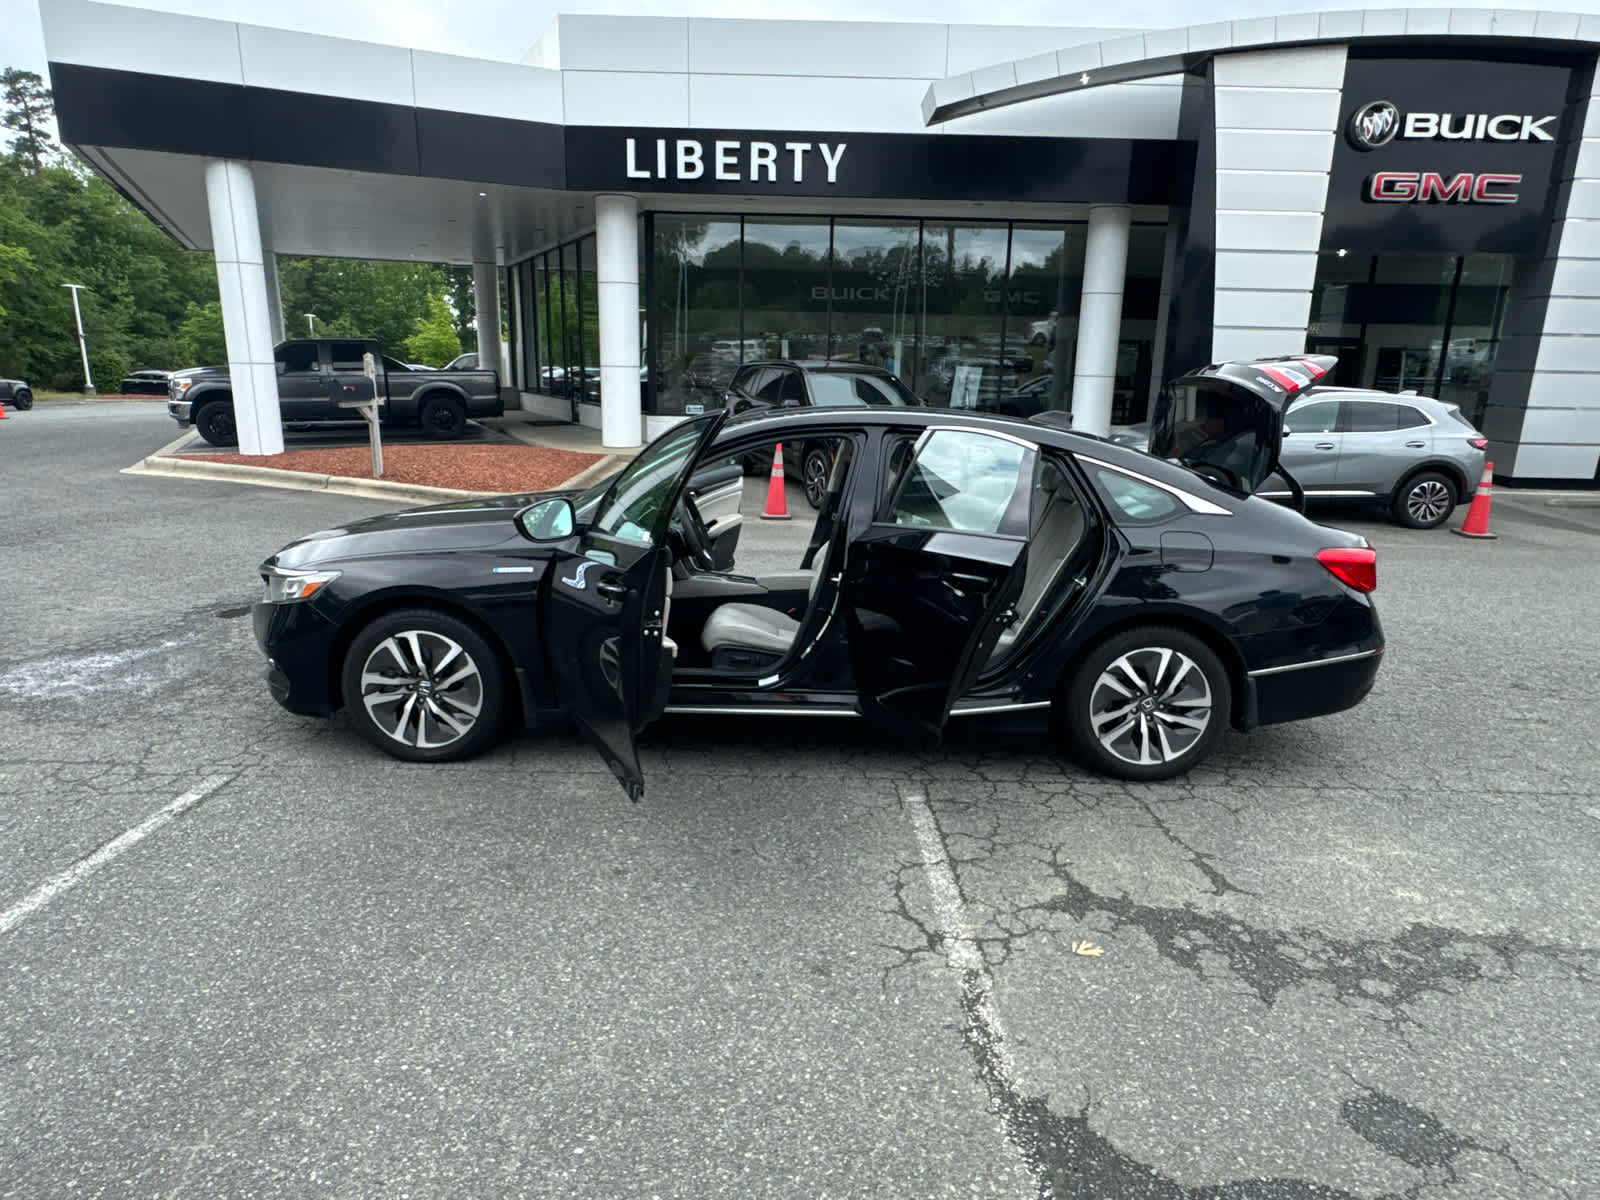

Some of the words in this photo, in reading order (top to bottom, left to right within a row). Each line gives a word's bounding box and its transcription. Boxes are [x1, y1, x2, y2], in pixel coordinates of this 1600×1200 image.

[1403, 112, 1557, 140] BUICK
[626, 137, 847, 183] LIBERTY
[1370, 171, 1522, 203] GMC
[811, 287, 891, 301] BUICK
